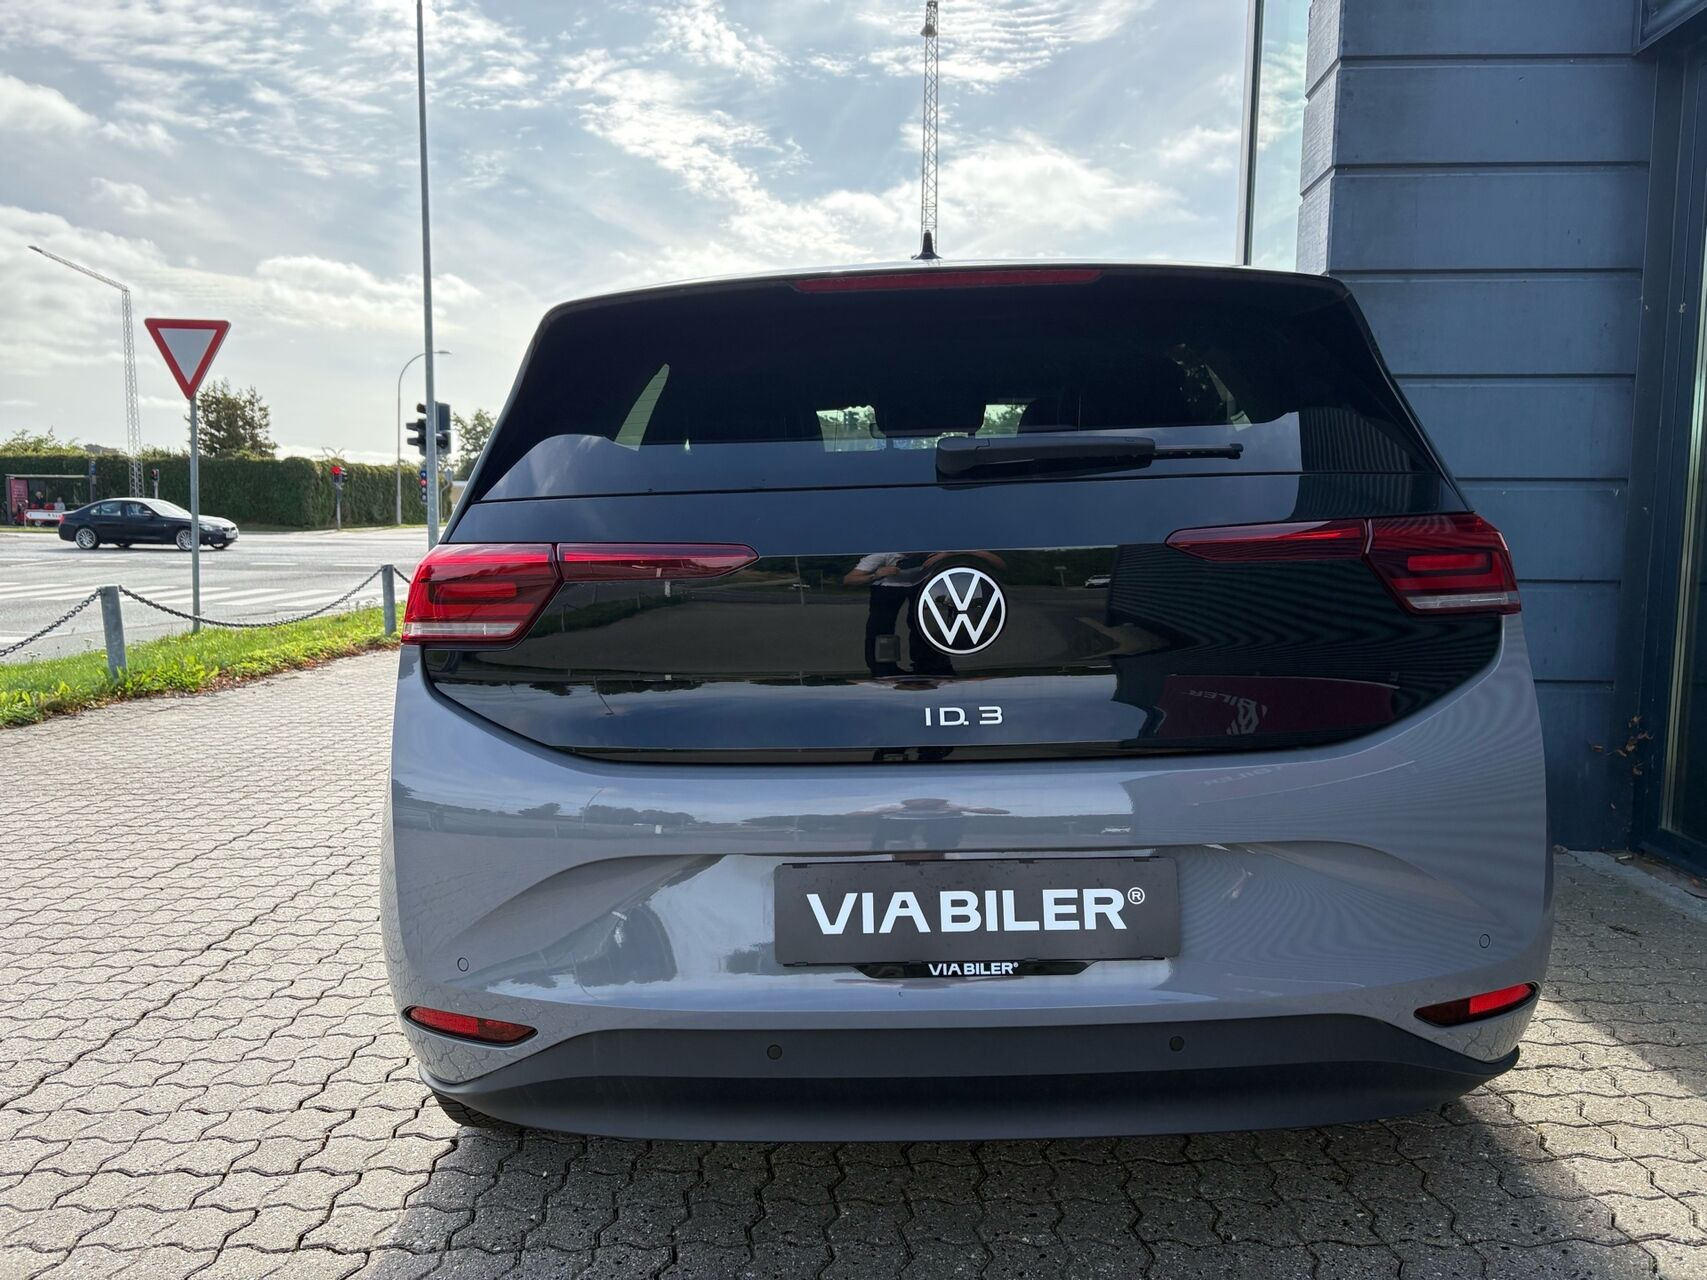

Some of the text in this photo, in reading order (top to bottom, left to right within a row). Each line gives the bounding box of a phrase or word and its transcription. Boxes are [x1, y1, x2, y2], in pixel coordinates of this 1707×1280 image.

[919, 568, 1005, 653] VW
[806, 891, 931, 935] VIA
[928, 963, 962, 976] VIA
